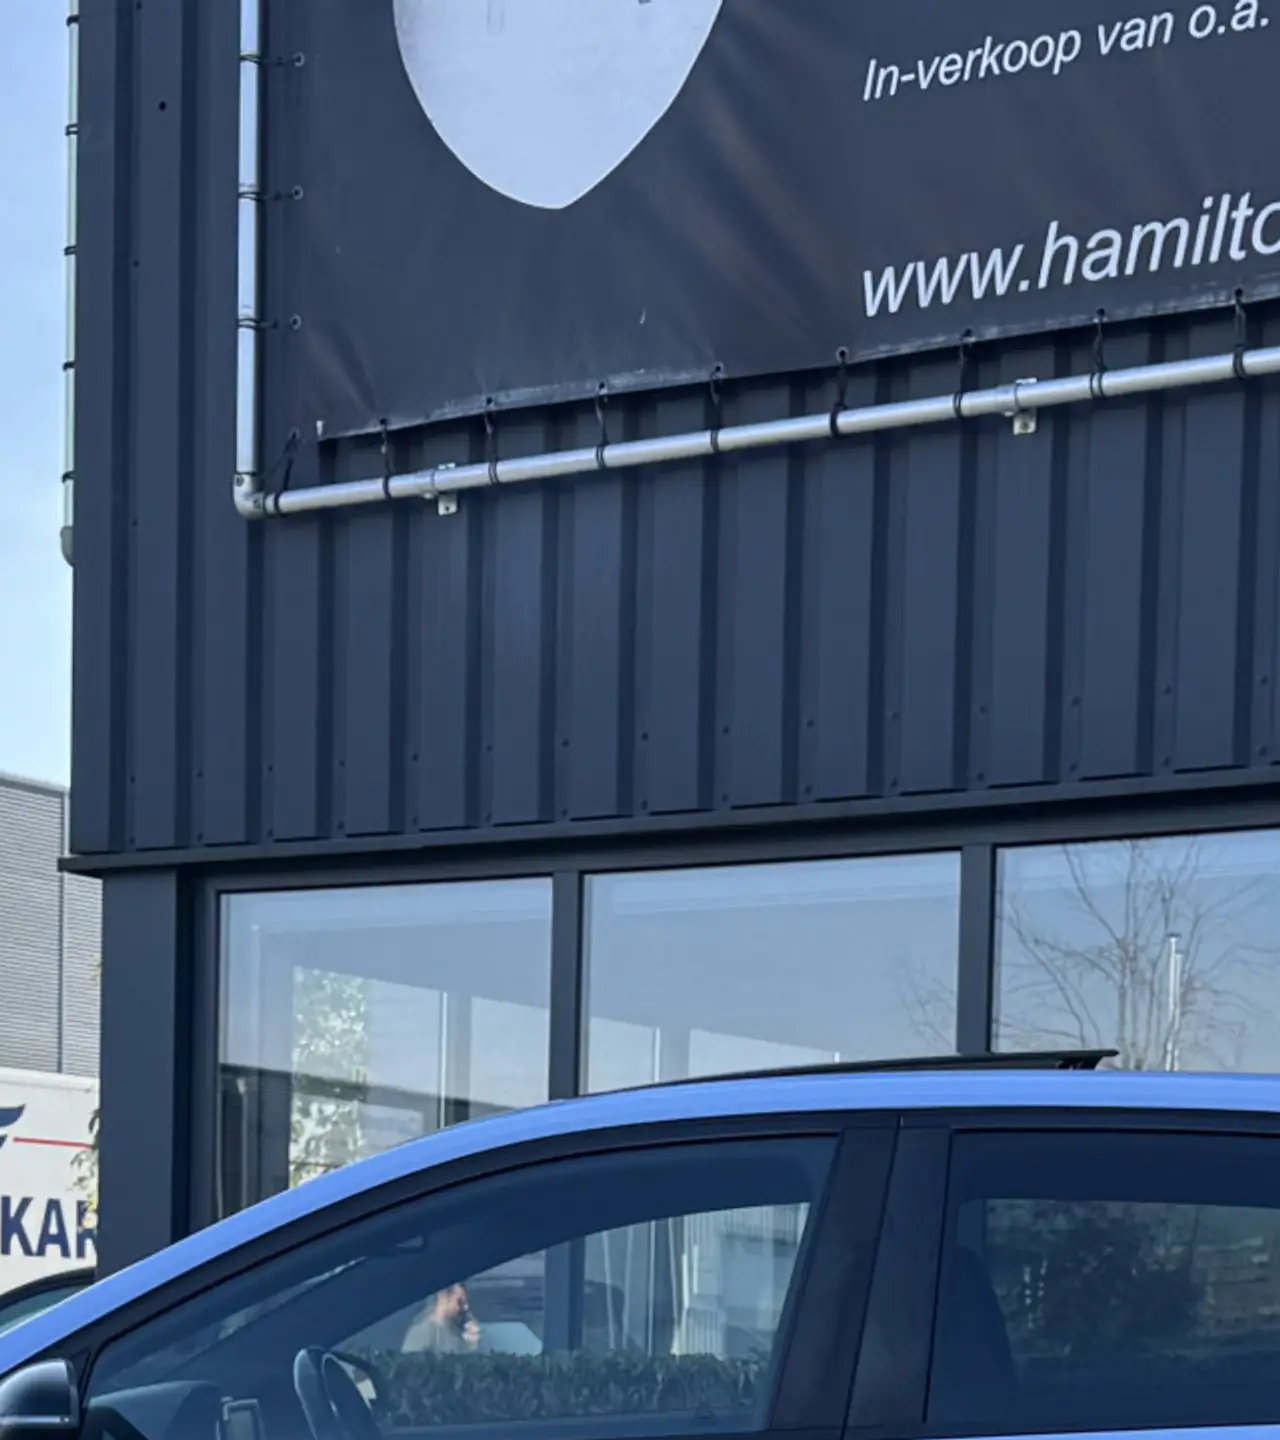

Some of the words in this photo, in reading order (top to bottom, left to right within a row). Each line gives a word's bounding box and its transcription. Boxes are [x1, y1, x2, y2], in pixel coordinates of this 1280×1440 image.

[863, 29, 1082, 101] In-verkoop
[1097, 11, 1174, 56] van
[1188, 0, 1269, 39] o.a.
